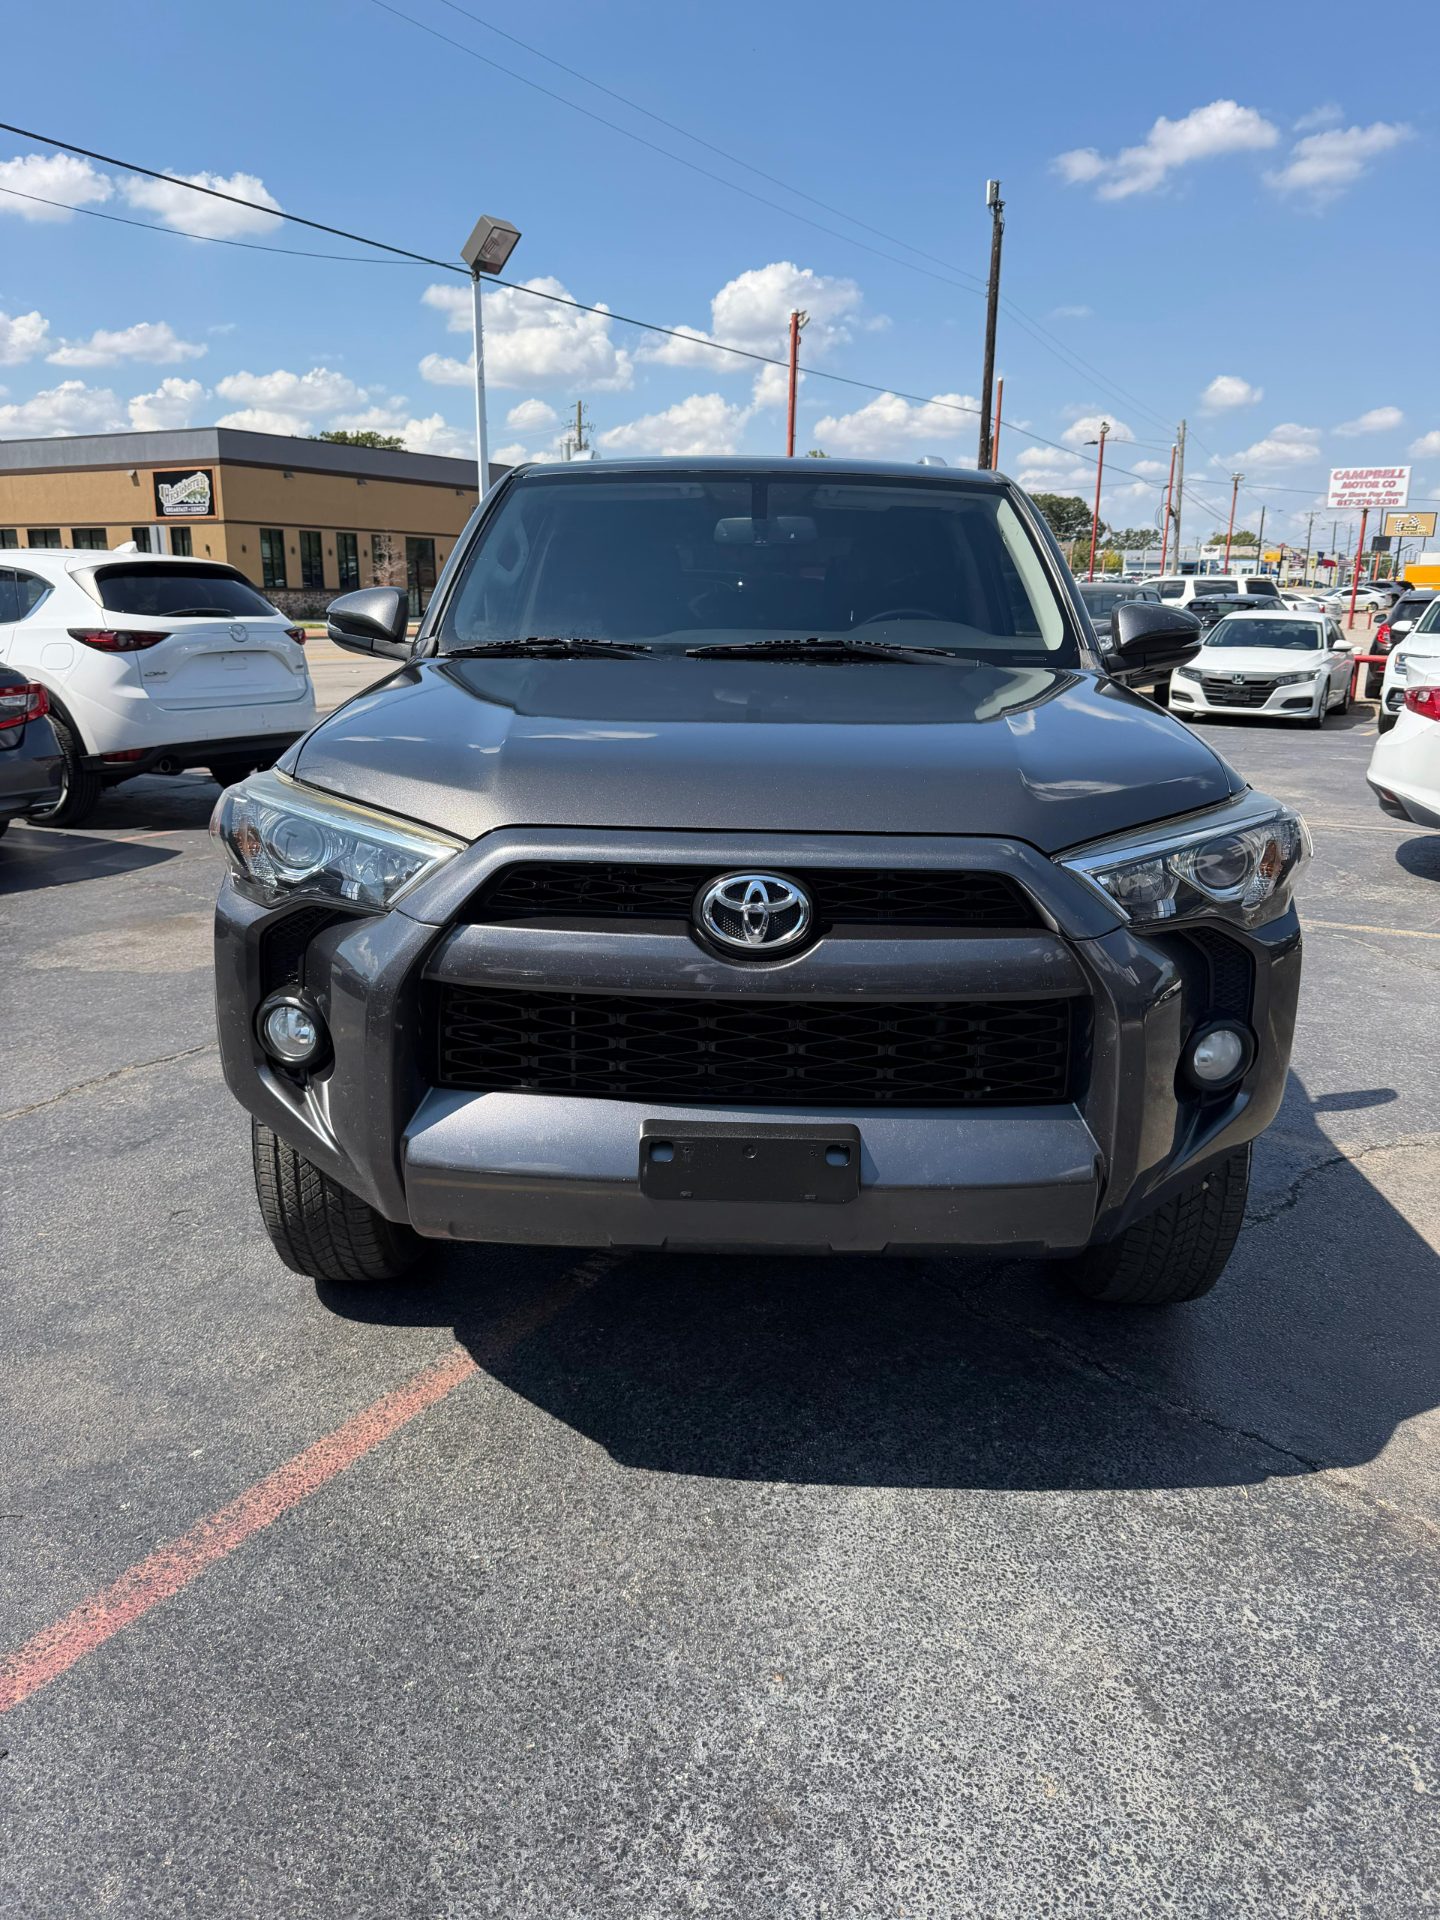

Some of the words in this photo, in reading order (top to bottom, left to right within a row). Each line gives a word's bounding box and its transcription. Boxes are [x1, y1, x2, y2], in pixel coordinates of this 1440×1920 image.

[1333, 469, 1406, 480] CAMPBELL
[1341, 481, 1379, 489] MOTOR
[1382, 480, 1396, 488] CO
